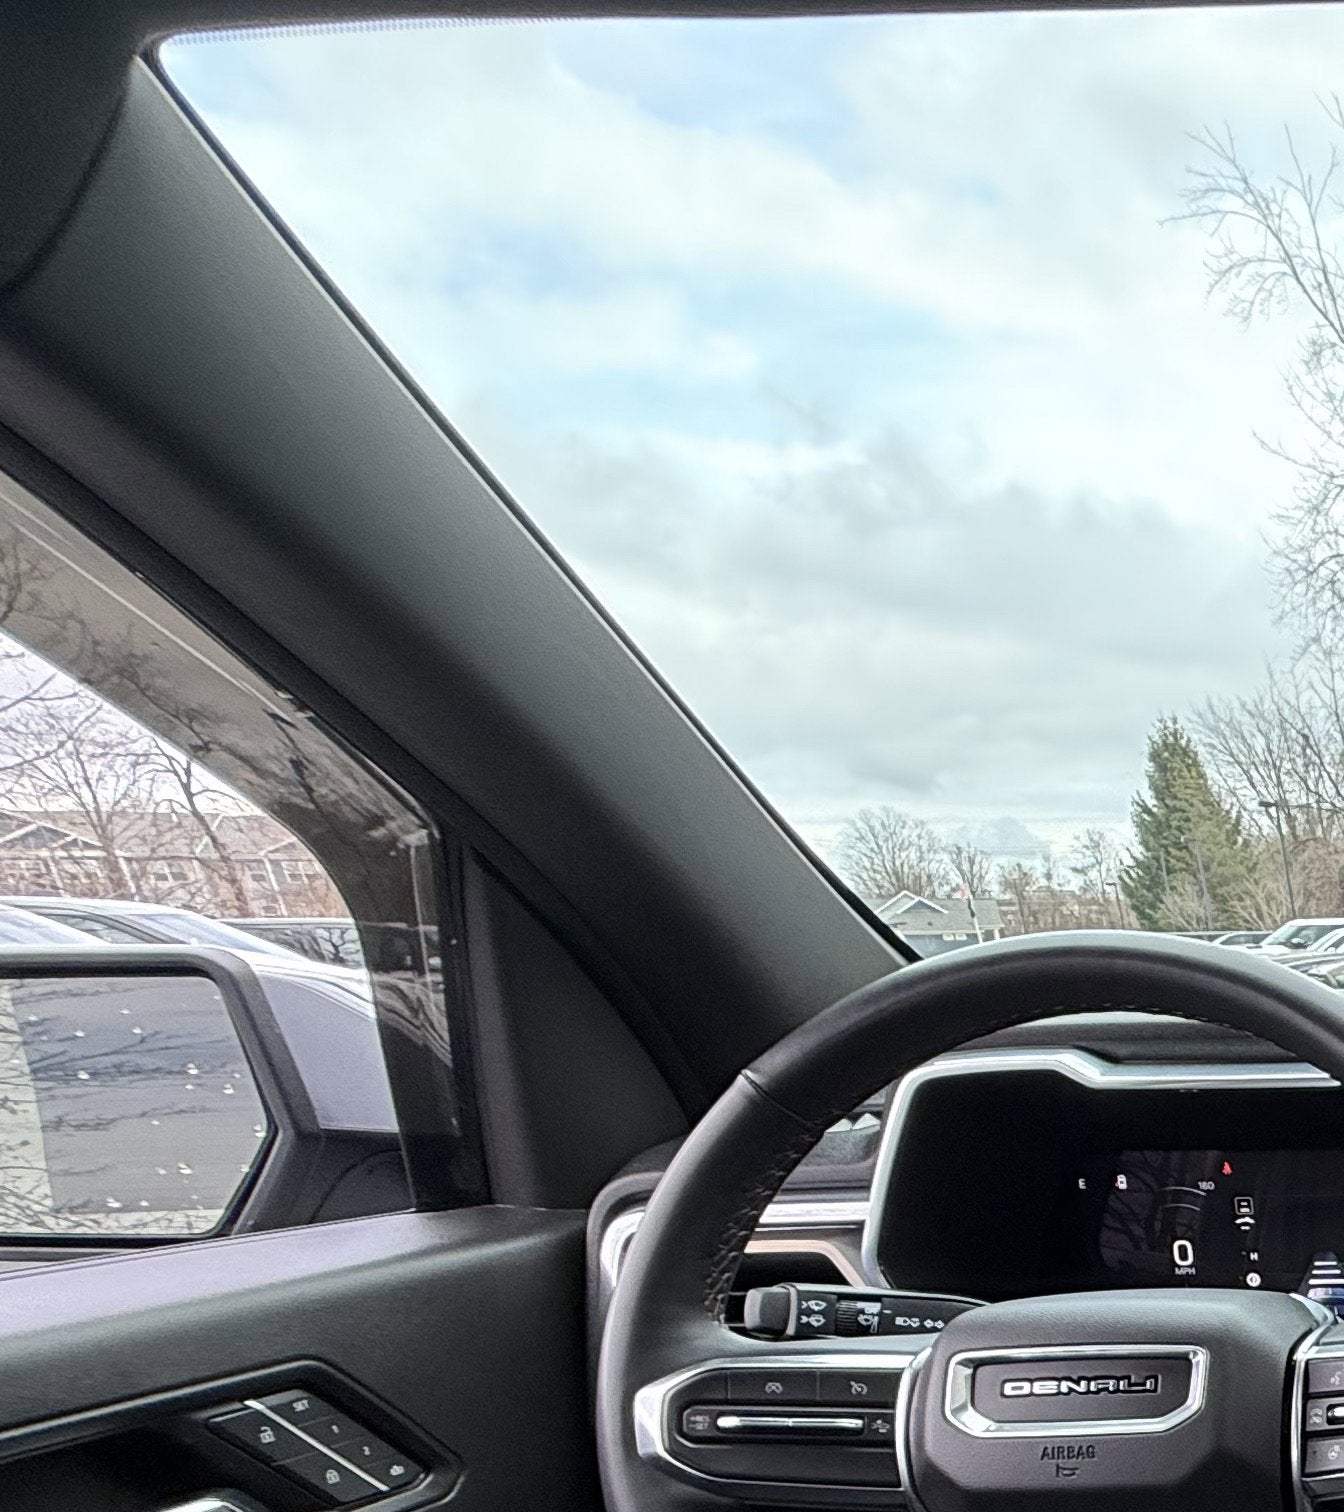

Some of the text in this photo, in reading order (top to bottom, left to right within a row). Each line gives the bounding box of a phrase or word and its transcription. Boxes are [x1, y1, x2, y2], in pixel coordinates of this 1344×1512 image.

[1172, 1239, 1195, 1267] 0
[1174, 1266, 1196, 1276] MPH
[1002, 1376, 1158, 1397] DENALI
[292, 1399, 310, 1413] SET
[1040, 1444, 1097, 1461] AIRBAG
